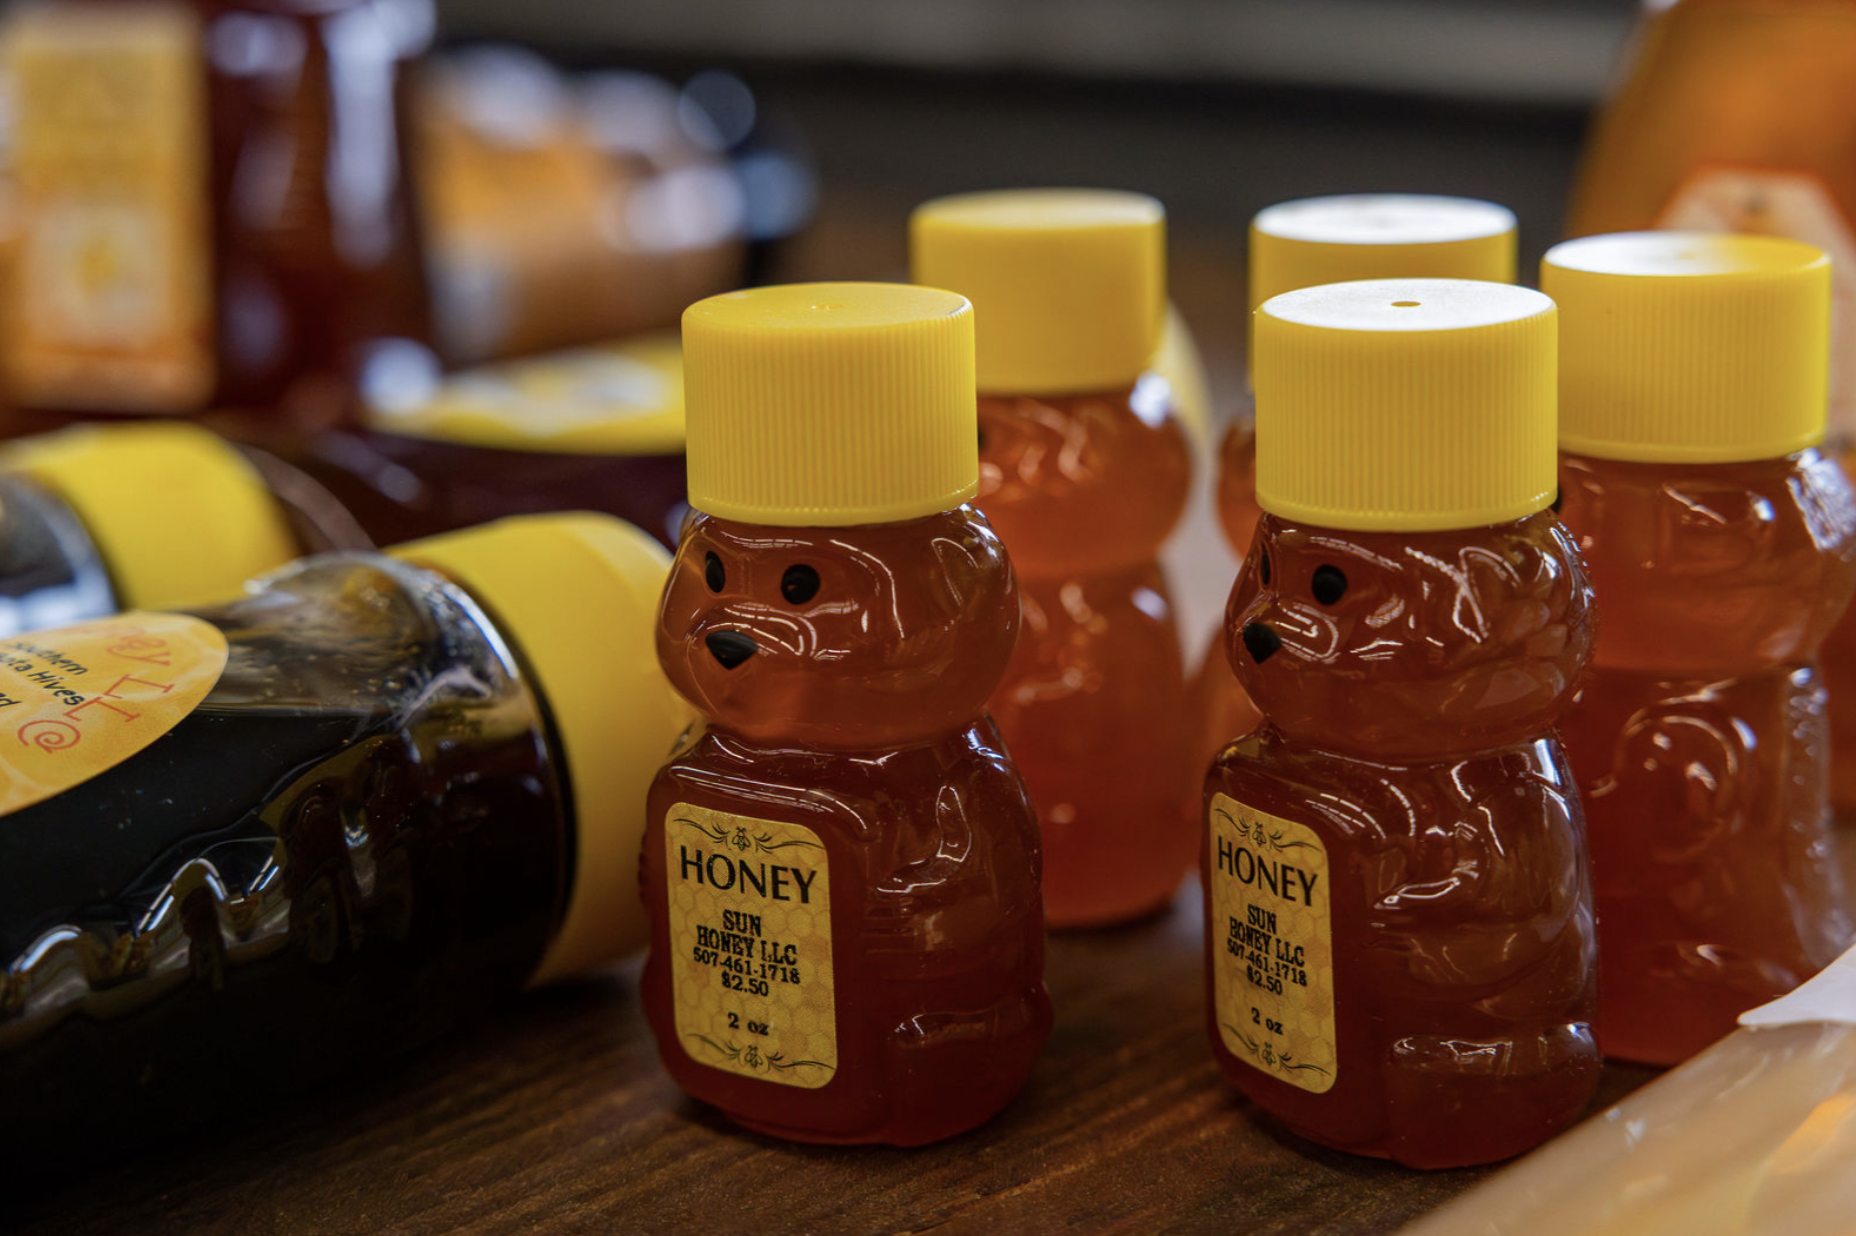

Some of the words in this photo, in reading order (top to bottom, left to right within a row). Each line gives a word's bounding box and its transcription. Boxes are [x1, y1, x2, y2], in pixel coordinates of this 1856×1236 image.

[26, 670, 86, 707] Hives
[680, 844, 818, 905] HONEY
[1217, 834, 1319, 908] HONEY
[722, 908, 762, 938] SUN
[1246, 903, 1277, 936] SUN
[696, 924, 757, 959] HONEY
[760, 939, 798, 966] LLC
[1229, 915, 1273, 956] HONEY
[1275, 937, 1306, 969] LLC
[720, 969, 770, 997] $2.50
[1246, 964, 1284, 996] $2.50
[727, 1011, 740, 1030] 2
[747, 1020, 769, 1036] oz
[1251, 1006, 1261, 1026] 2
[1265, 1017, 1285, 1036] oz
